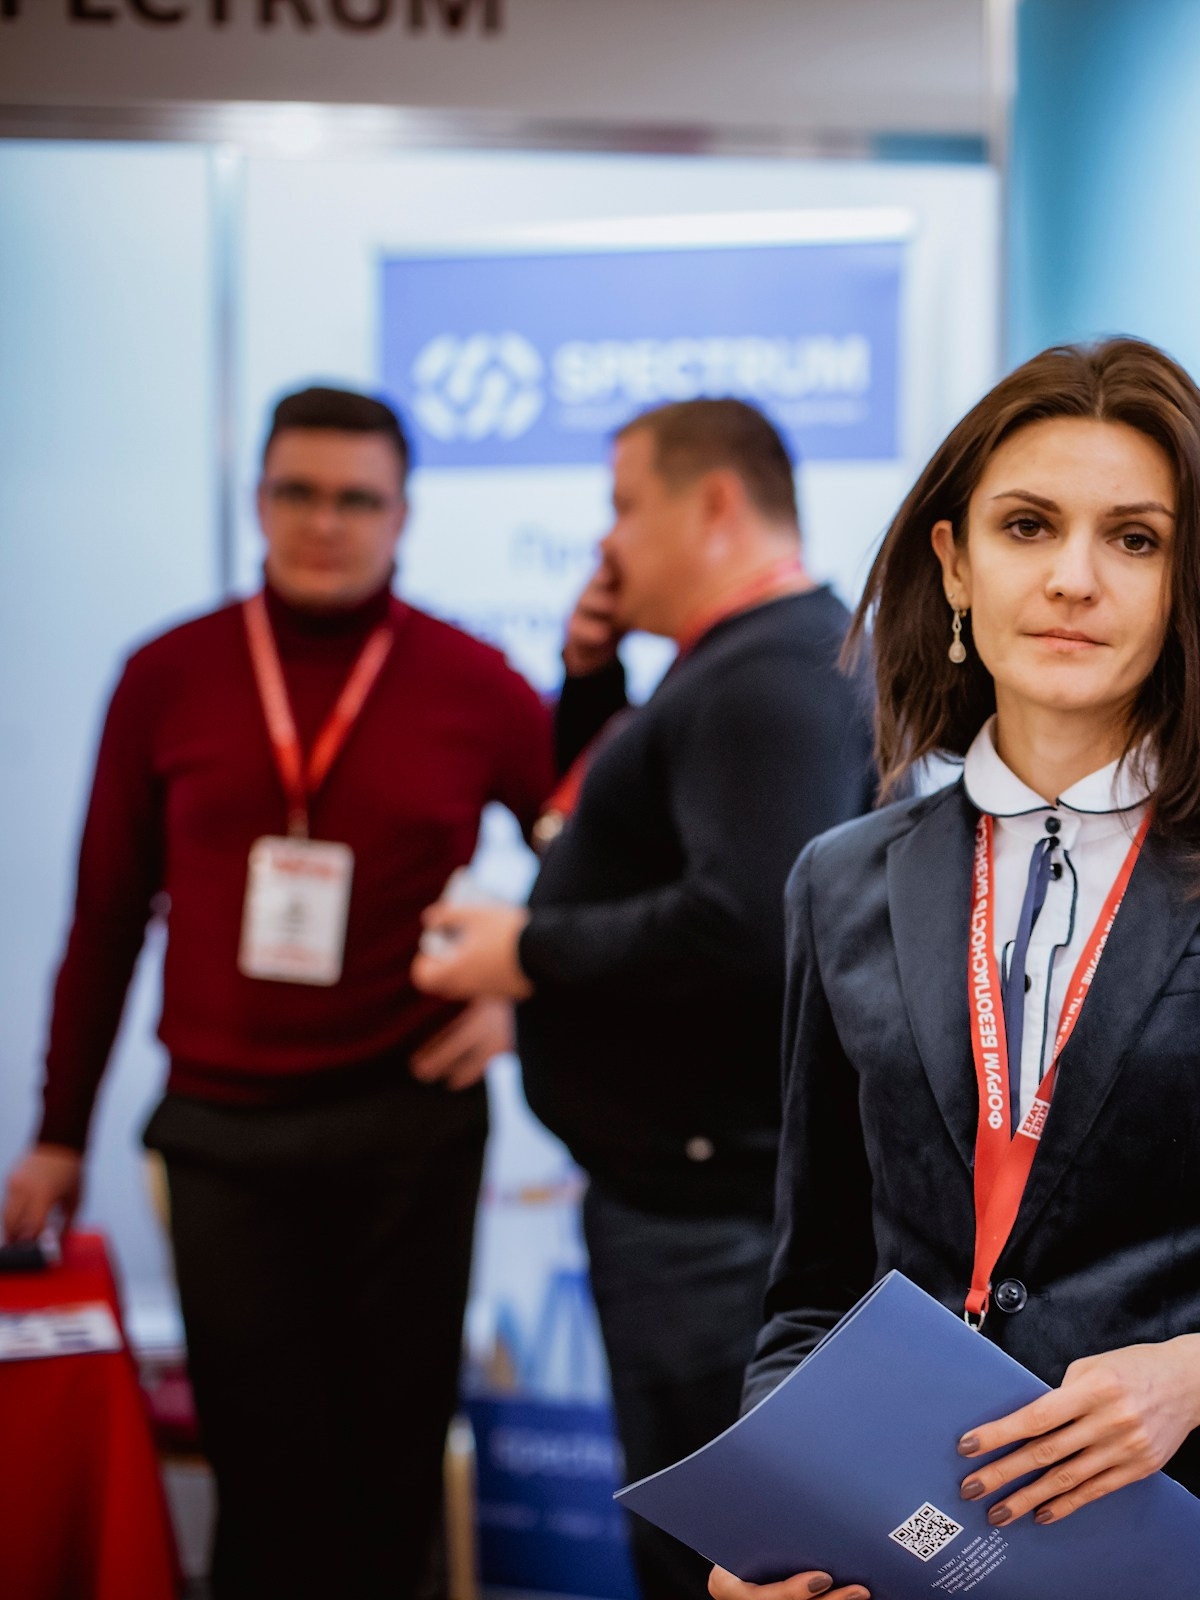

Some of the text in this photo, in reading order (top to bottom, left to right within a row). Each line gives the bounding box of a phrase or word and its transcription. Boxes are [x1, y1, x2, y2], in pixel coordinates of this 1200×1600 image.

[555, 333, 870, 398] SPECTRUM
[971, 813, 1003, 1130] ФОРУМ БЕЗОПАСНОСТЬ БИЗНЕСА
